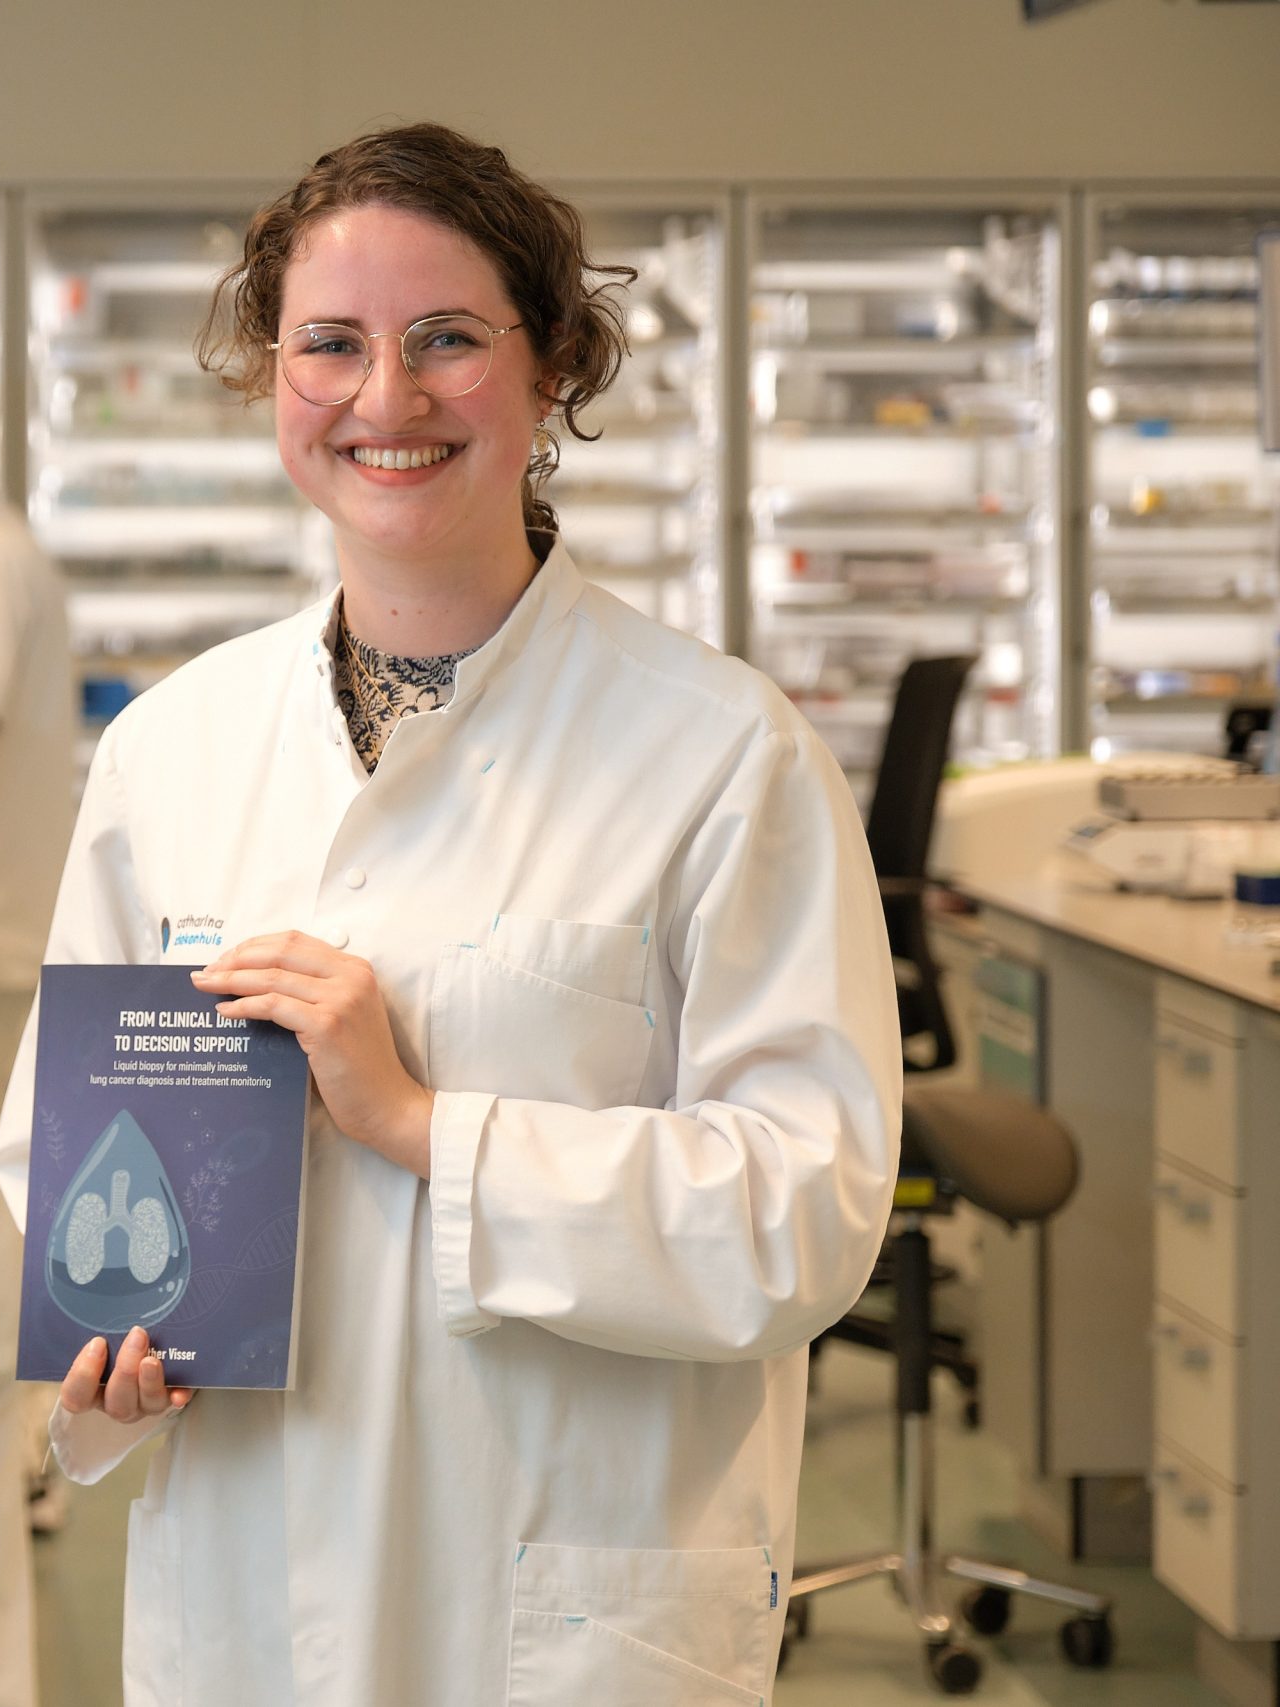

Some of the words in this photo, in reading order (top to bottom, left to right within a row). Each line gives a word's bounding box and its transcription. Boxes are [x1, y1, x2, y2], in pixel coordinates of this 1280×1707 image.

[177, 913, 224, 929] catharina
[119, 1010, 155, 1028] FROM
[158, 1011, 213, 1028] CLINICAL
[114, 1035, 131, 1051] TO
[133, 1035, 190, 1052] DECISION
[193, 1036, 250, 1053] SUPPORT
[113, 1060, 138, 1072] Liquid
[138, 1060, 165, 1074] biopsy
[166, 1061, 178, 1072] for
[178, 1061, 216, 1074] minimally
[217, 1062, 248, 1073] invasive
[90, 1074, 107, 1087] lung
[108, 1076, 135, 1086] cancer
[136, 1075, 174, 1088] diagnosis
[175, 1075, 191, 1087] and
[191, 1076, 229, 1087] treatment
[230, 1076, 272, 1089] monitoring
[147, 1347, 167, 1360] ther
[168, 1347, 197, 1361] Visser
